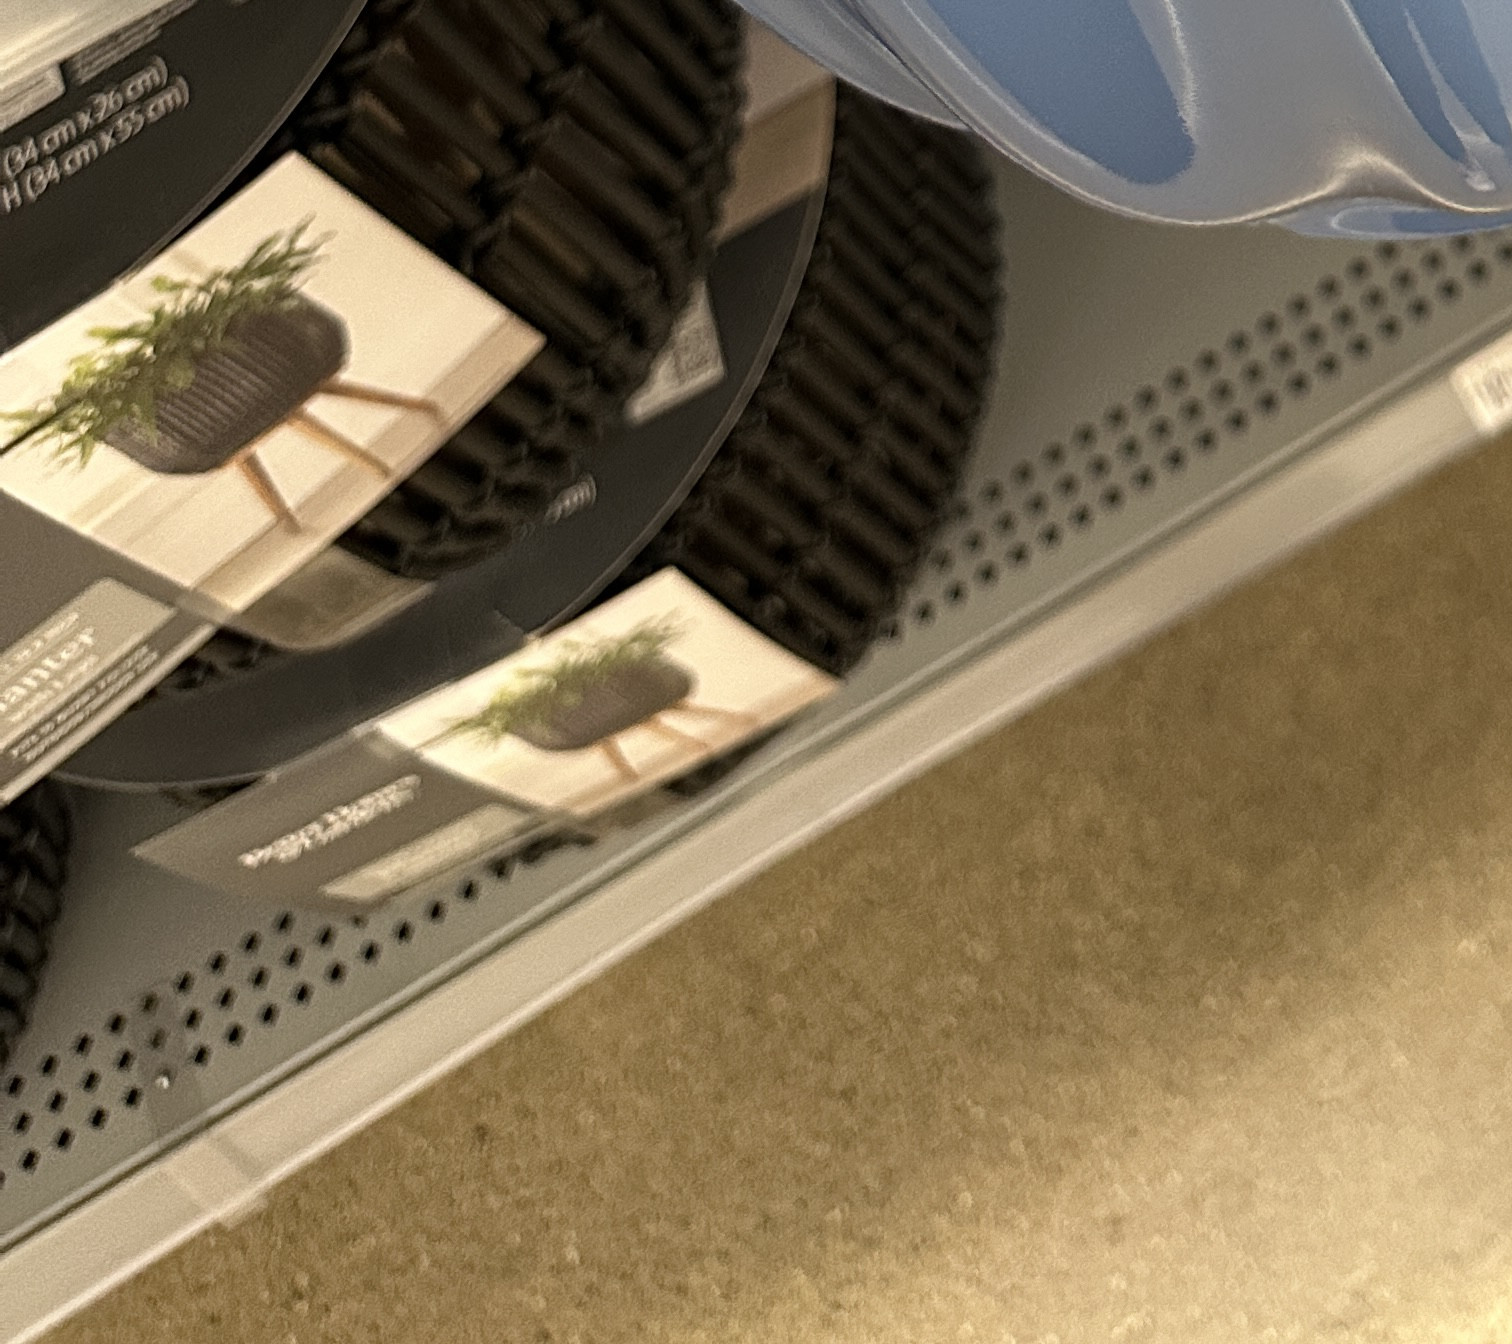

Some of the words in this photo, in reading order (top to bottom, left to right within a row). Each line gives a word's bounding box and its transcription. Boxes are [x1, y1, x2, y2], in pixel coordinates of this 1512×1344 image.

[38, 118, 76, 155] cm
[121, 55, 168, 103] cm)
[58, 139, 98, 176] cm
[142, 75, 189, 124] cm)
